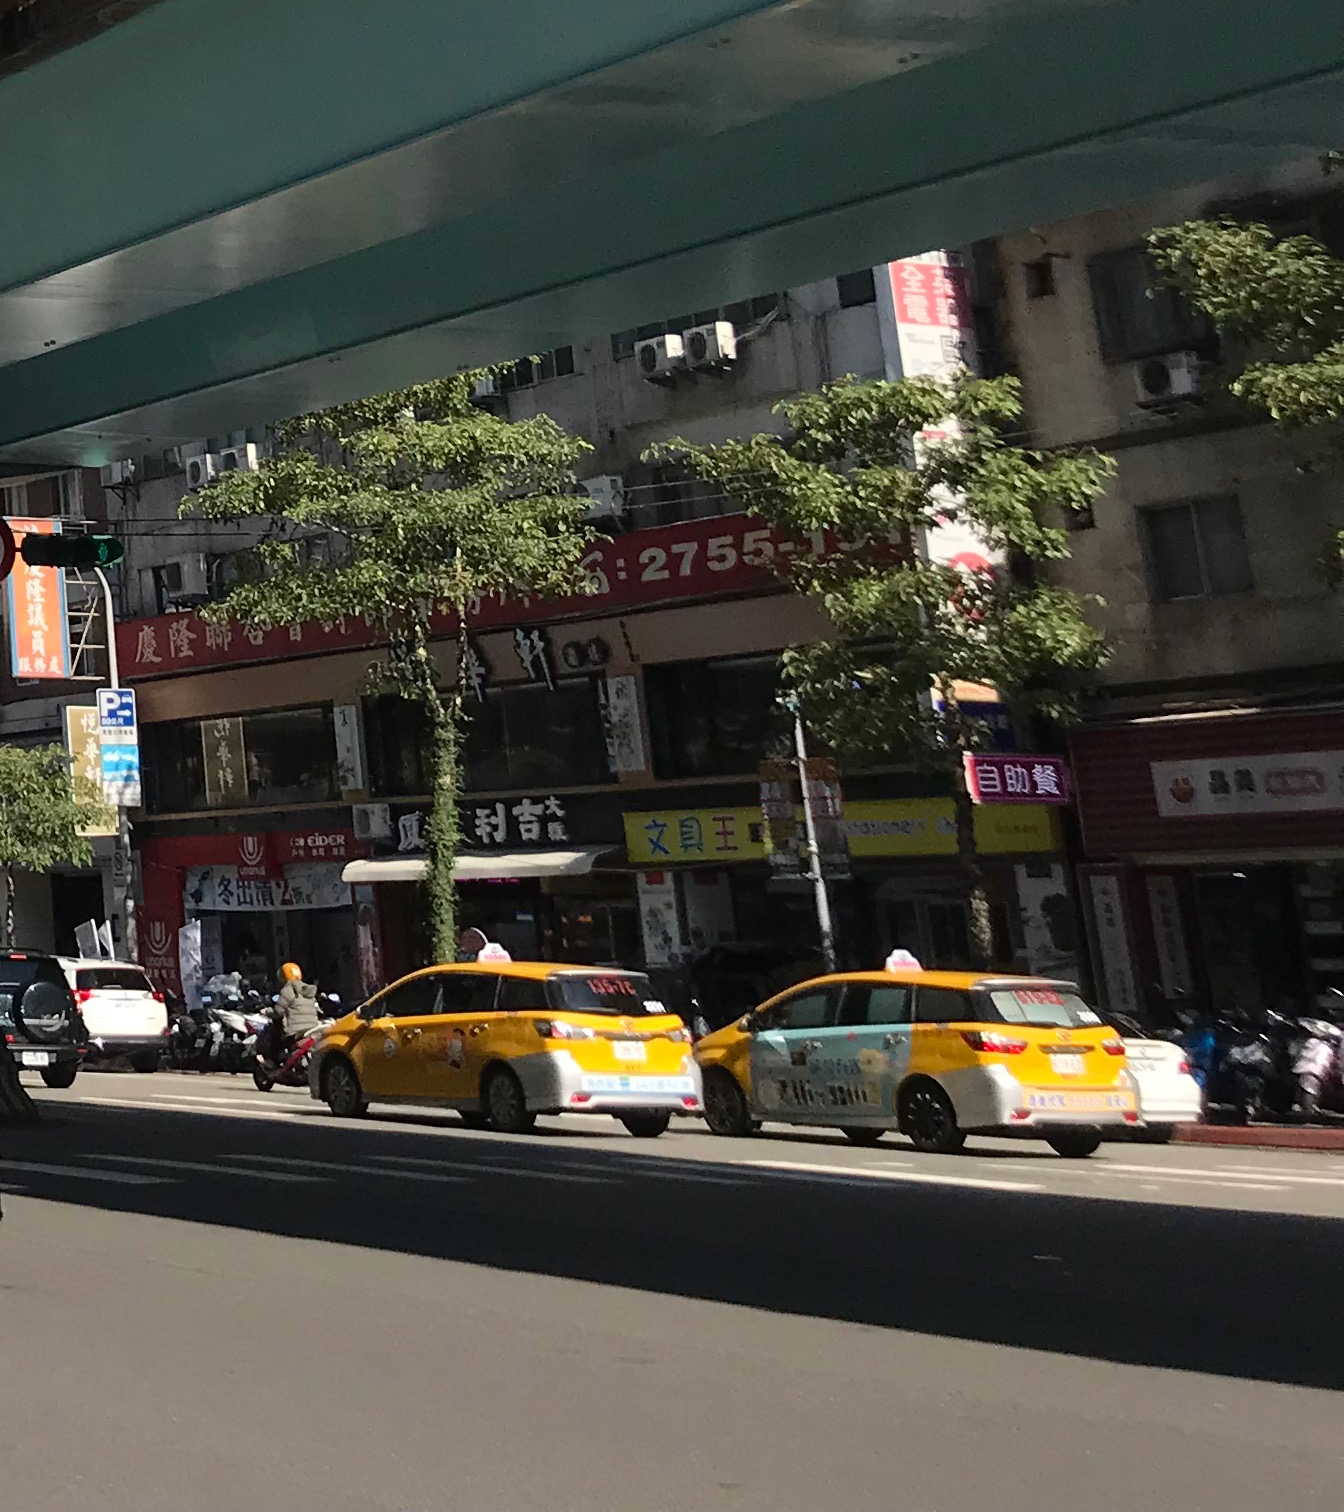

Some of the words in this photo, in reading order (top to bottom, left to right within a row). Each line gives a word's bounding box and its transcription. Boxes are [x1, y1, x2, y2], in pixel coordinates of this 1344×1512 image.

[100, 692, 120, 716] P
[975, 762, 1062, 796] 自助餐
[643, 815, 738, 856] 文具王
